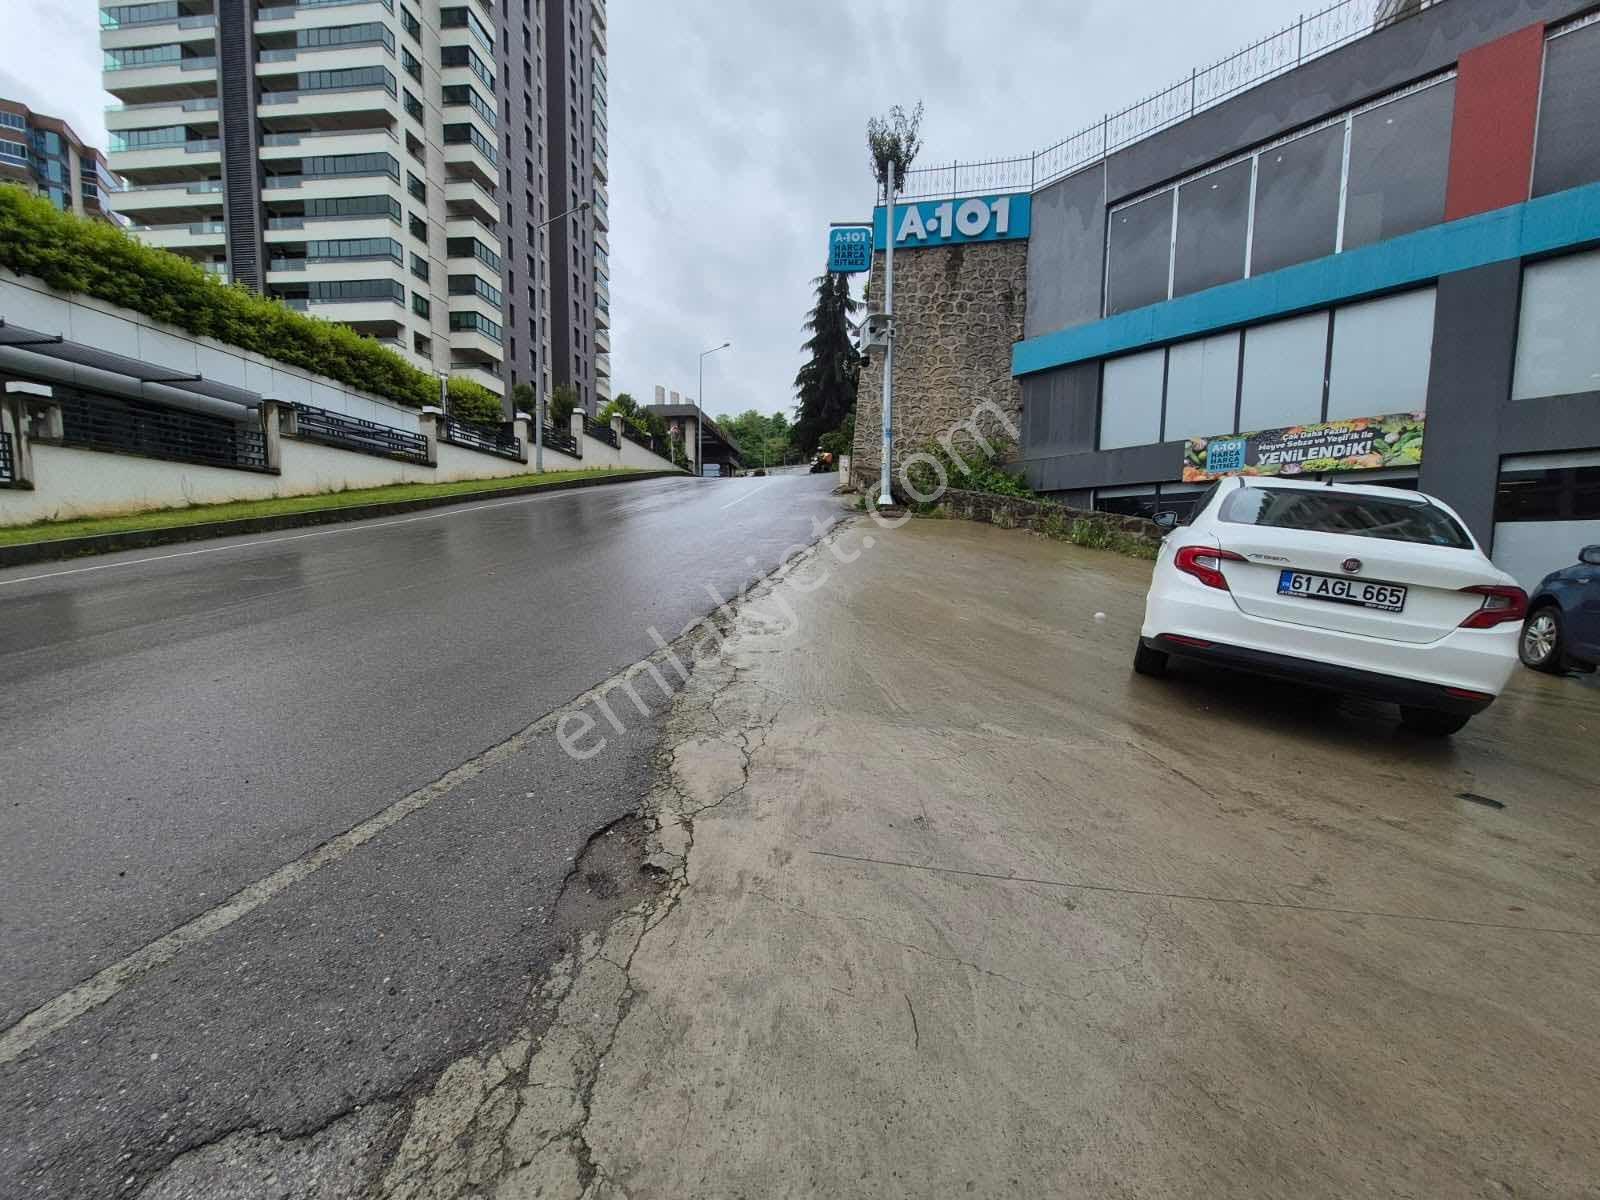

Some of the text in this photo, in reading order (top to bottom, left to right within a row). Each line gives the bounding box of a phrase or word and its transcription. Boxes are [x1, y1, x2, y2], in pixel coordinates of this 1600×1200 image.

[1301, 429, 1323, 438] Daha
[1324, 427, 1348, 436] Fazla
[1258, 443, 1286, 452] Meyve
[1287, 439, 1313, 448] Sebze
[1211, 450, 1240, 458] HARCA
[1211, 456, 1240, 465] HARCA
[1292, 575, 1312, 592] 61
[1317, 579, 1357, 599] AGL
[1363, 585, 1403, 604] 665
